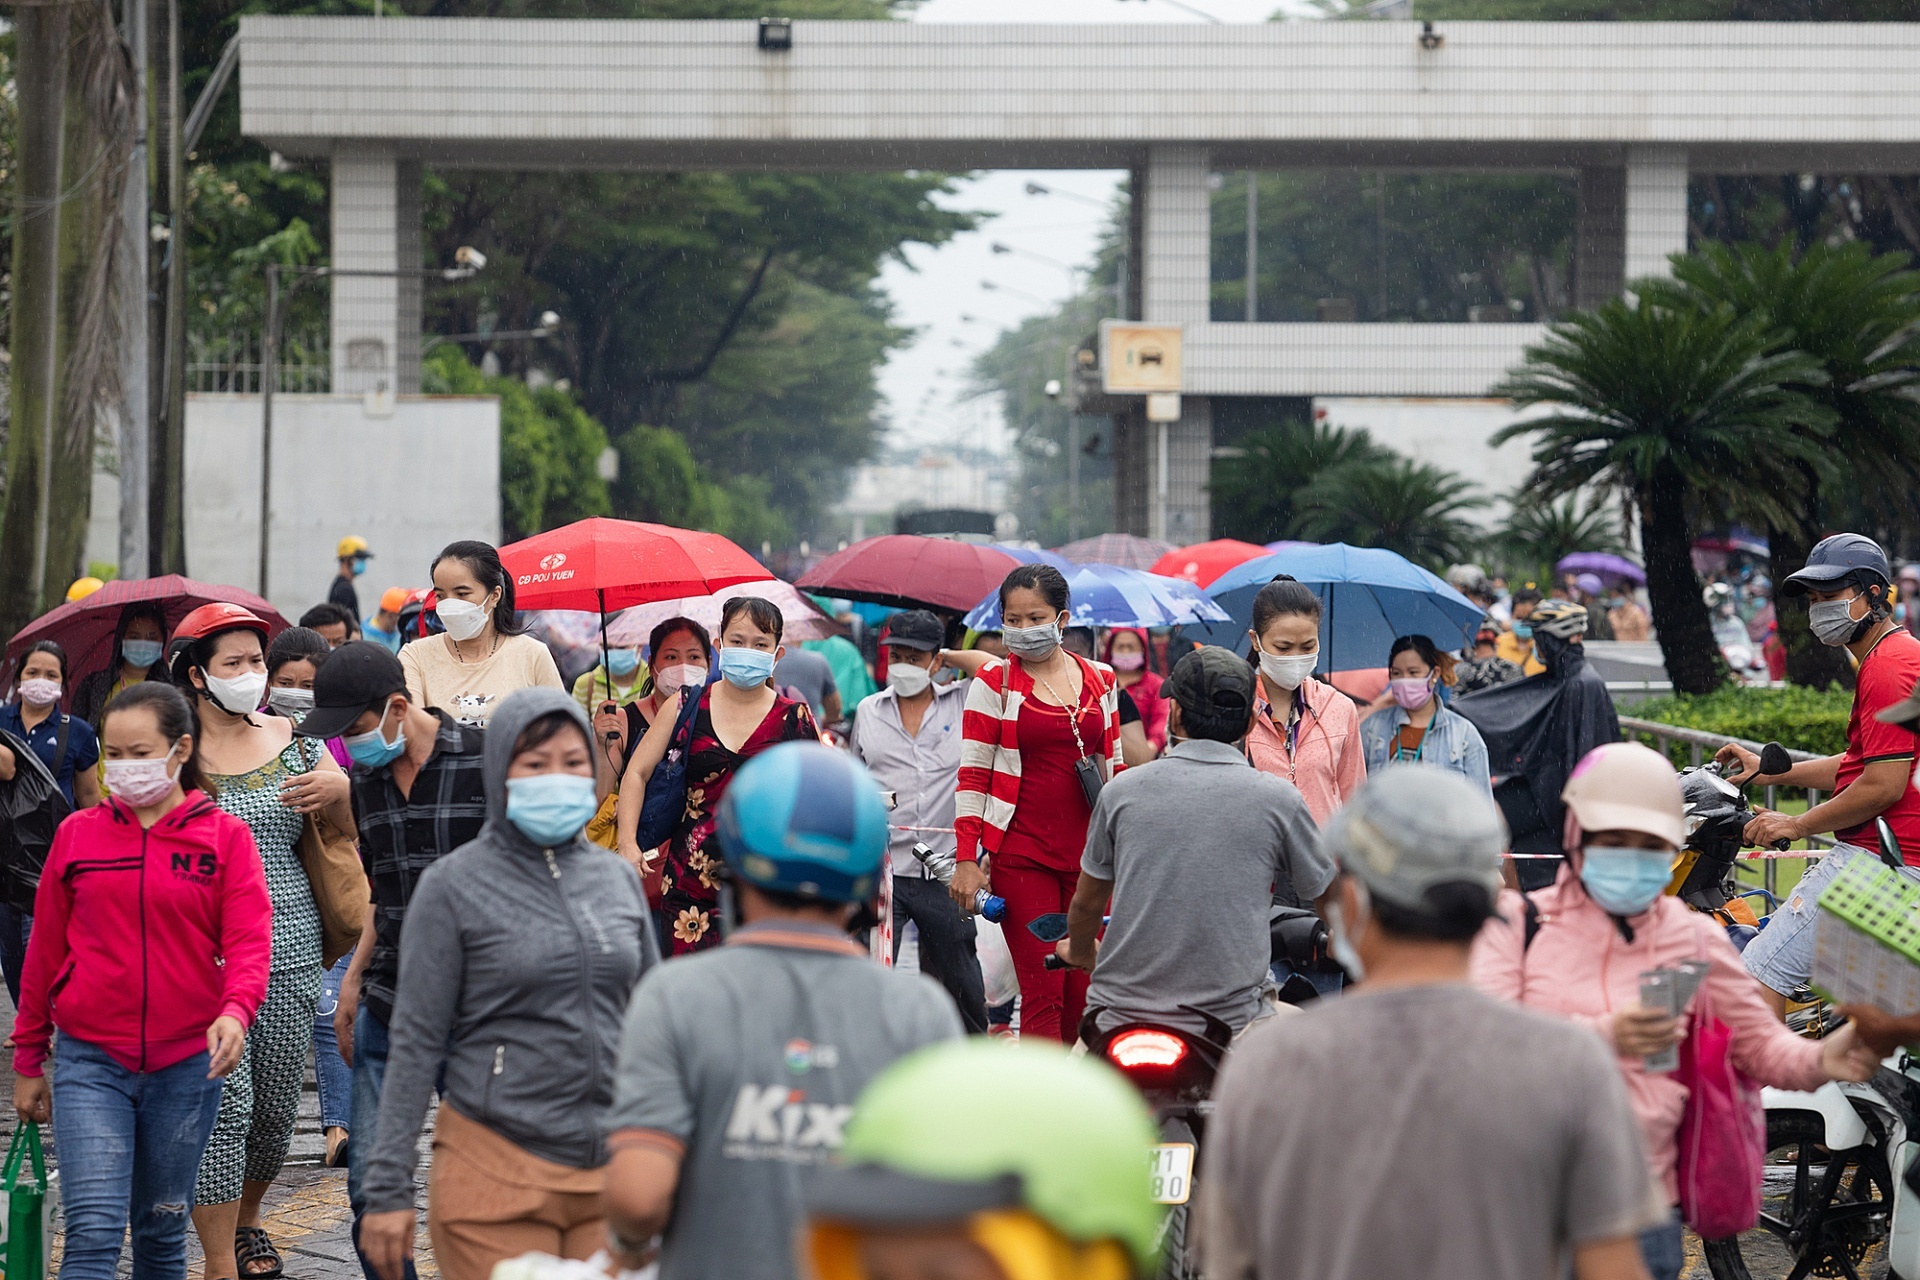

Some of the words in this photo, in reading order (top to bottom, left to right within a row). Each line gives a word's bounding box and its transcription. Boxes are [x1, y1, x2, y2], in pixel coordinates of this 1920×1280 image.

[532, 573, 550, 583] POU
[552, 570, 575, 580] YUEN
[725, 1083, 854, 1149] Kix
